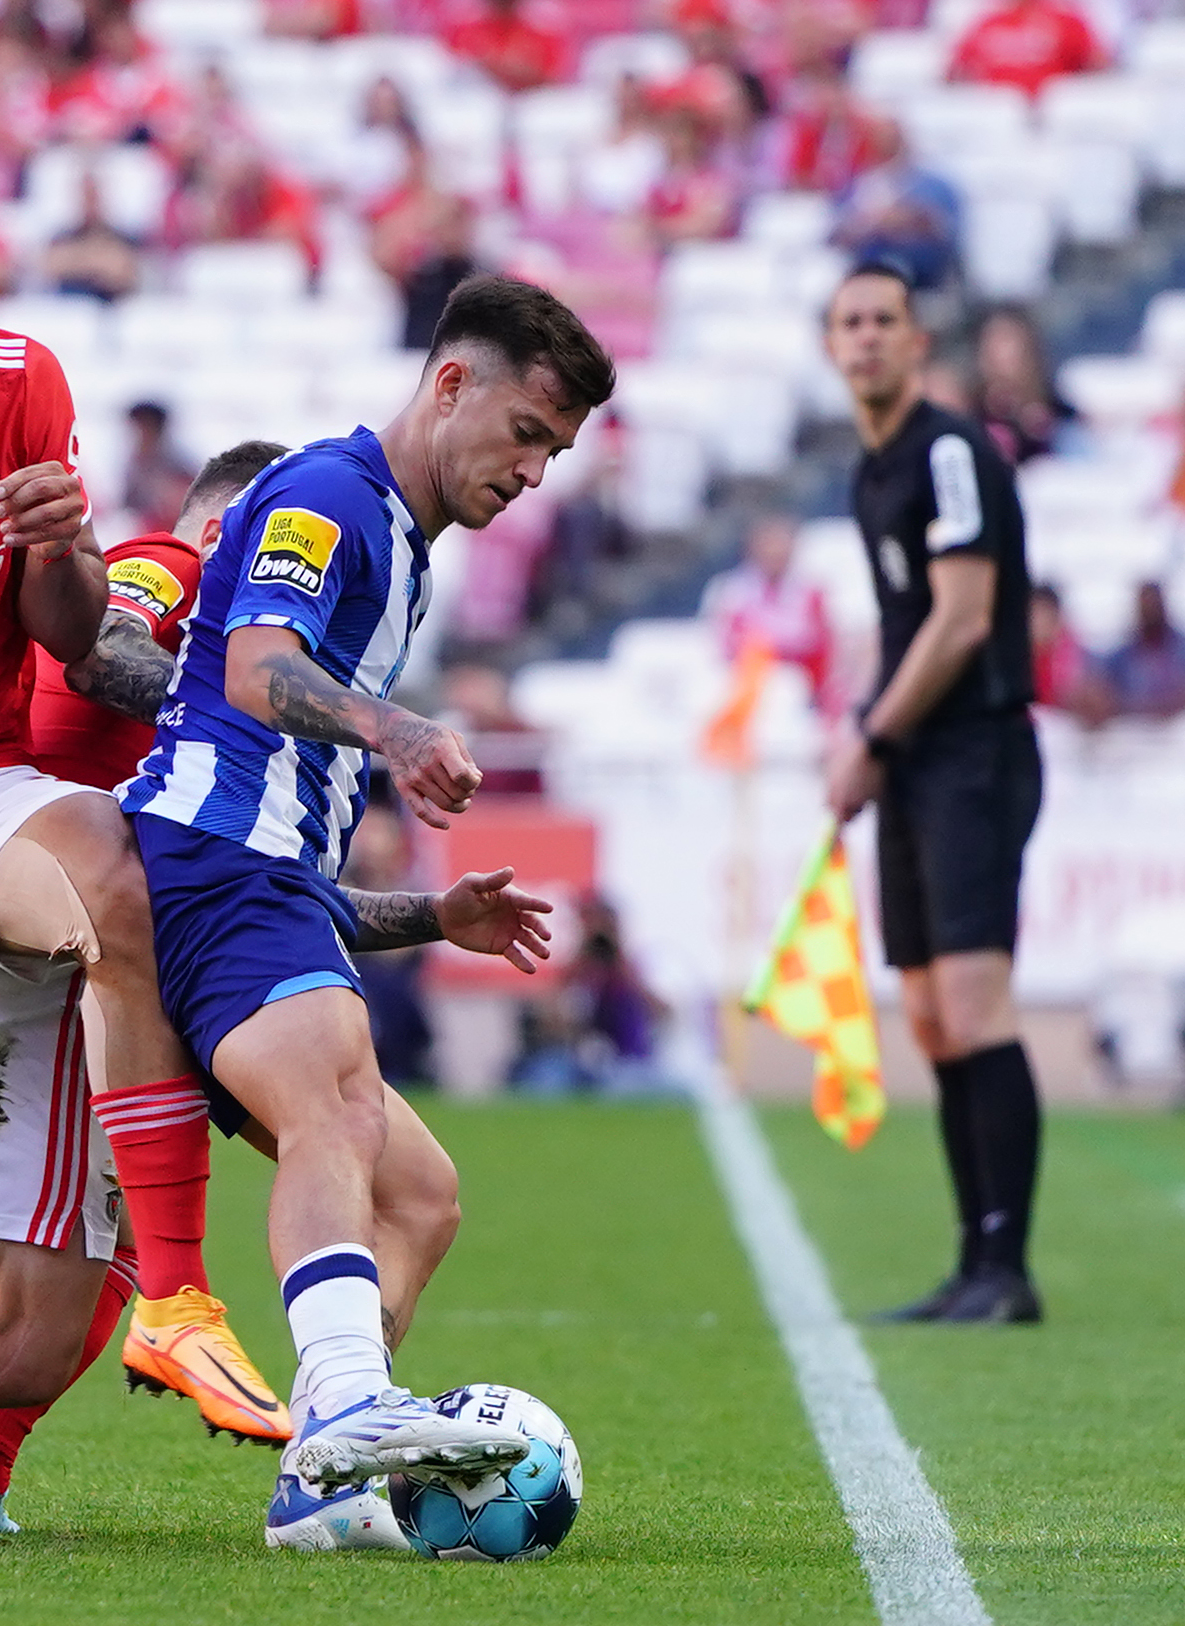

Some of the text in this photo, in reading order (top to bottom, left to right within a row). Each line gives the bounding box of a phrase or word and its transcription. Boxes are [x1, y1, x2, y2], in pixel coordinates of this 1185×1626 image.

[272, 517, 292, 530] LIGA
[268, 530, 314, 555] PORTUGAL
[118, 562, 141, 570] LIGA
[253, 554, 319, 590] bwin
[113, 569, 163, 593] PORTUGAL
